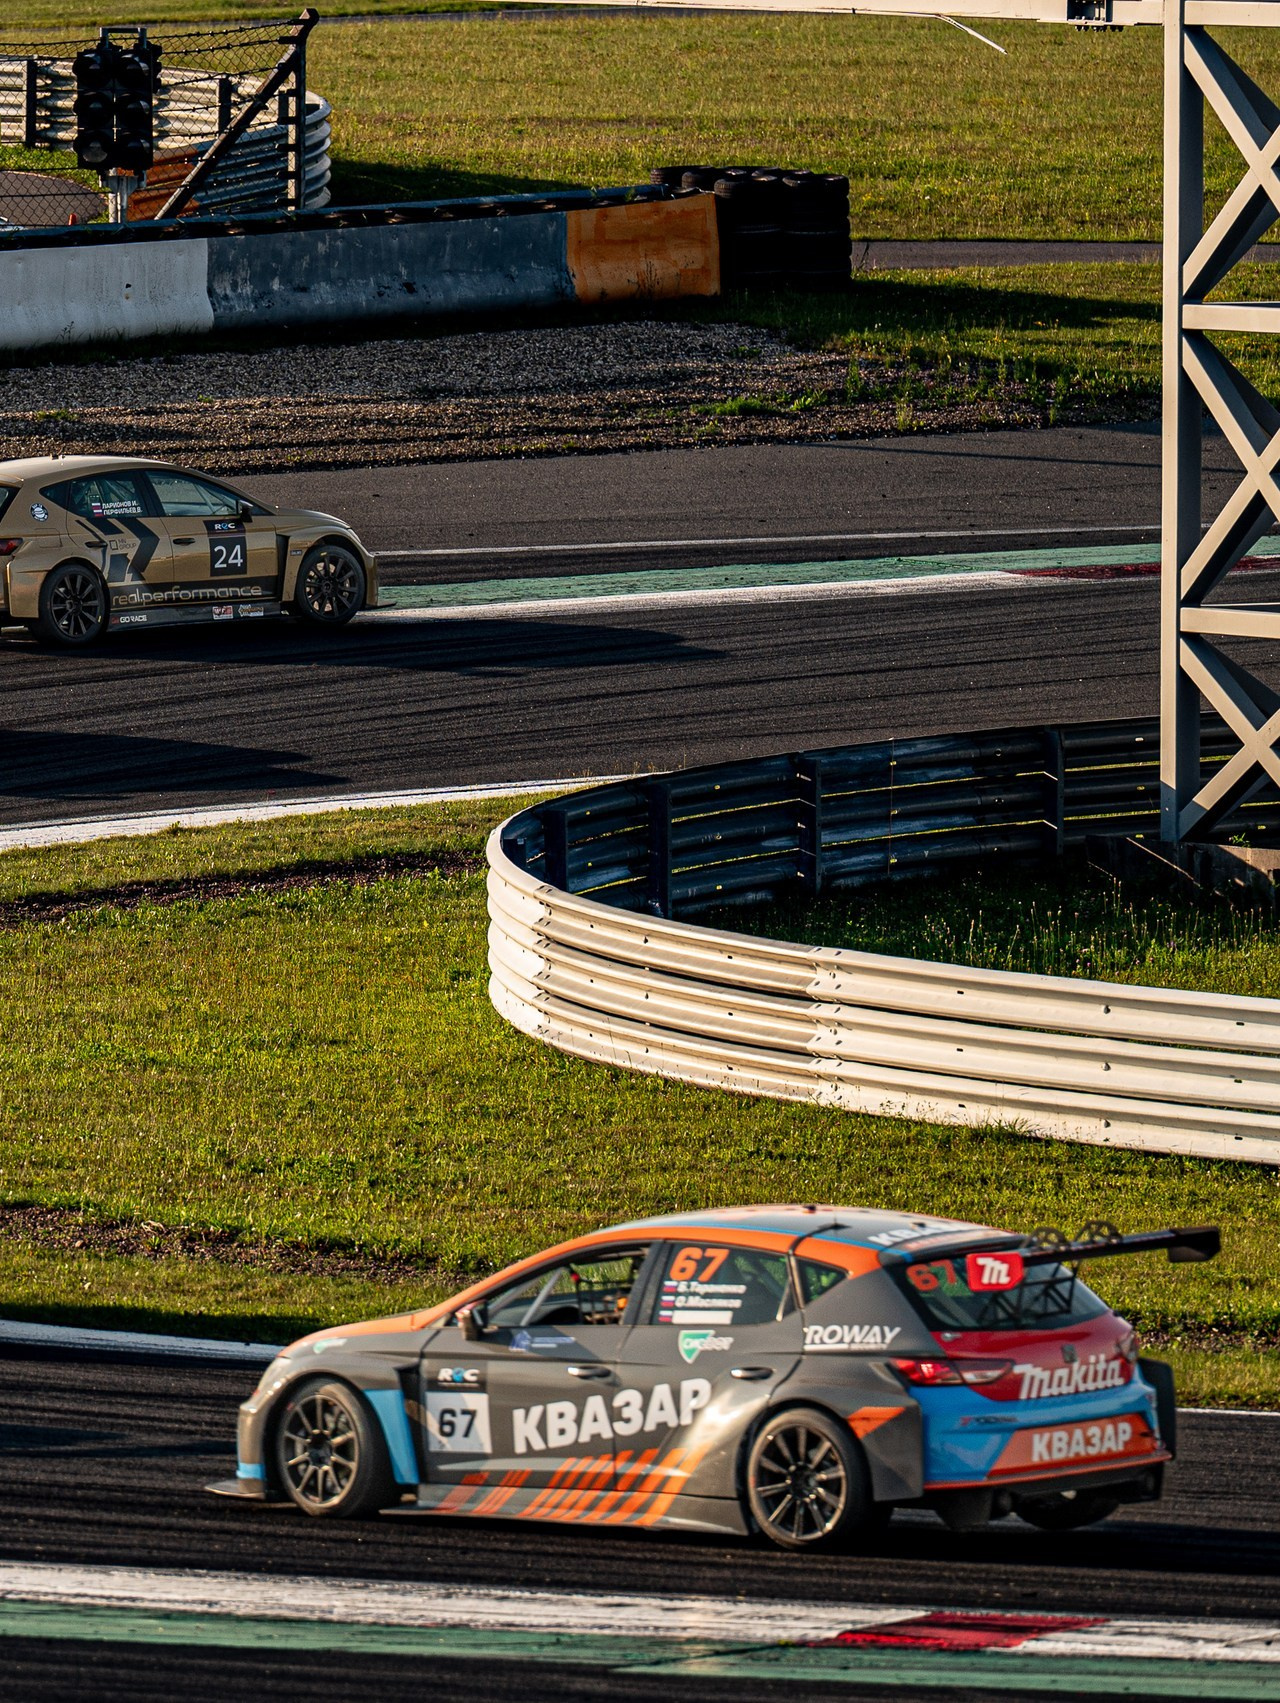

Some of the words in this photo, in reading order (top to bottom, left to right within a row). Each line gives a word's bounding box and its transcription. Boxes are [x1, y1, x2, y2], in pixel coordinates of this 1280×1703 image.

[213, 544, 244, 569] 24
[669, 1246, 730, 1282] 67
[907, 1259, 957, 1291] 67
[439, 1407, 477, 1438] 67
[512, 1377, 712, 1454] КВАЗАР
[1031, 1421, 1133, 1462] КВАЗАР
